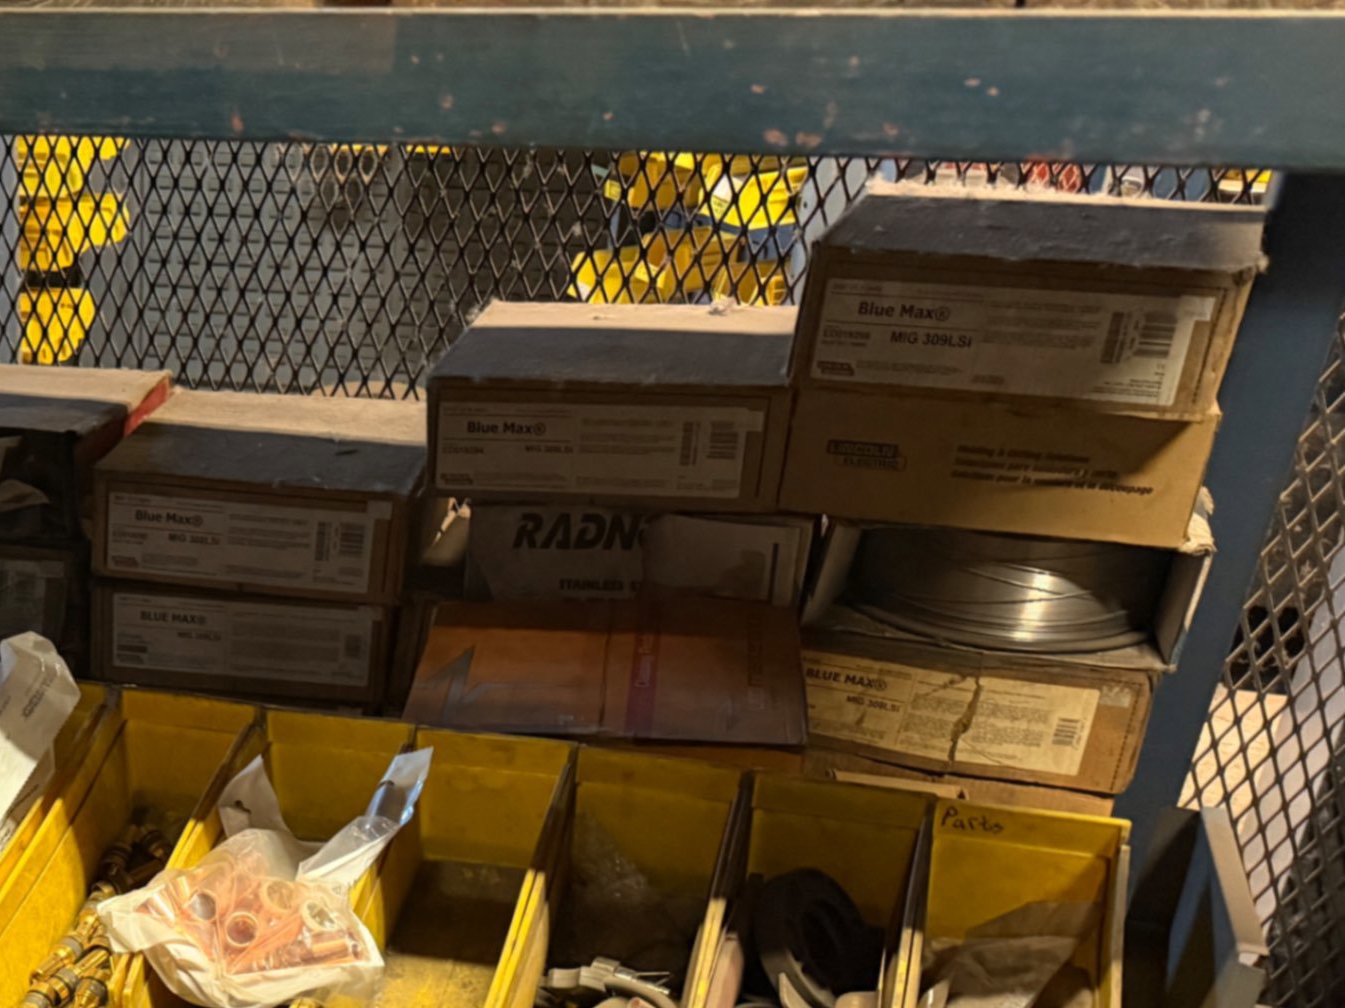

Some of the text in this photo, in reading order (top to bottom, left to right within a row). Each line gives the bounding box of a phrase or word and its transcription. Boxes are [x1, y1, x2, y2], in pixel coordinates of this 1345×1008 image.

[857, 301, 895, 318] Blue
[889, 330, 919, 345] MIG
[466, 421, 499, 434] Blue
[134, 509, 163, 523] Blue
[512, 512, 645, 551] RADN
[140, 610, 170, 622] BLUE
[805, 667, 840, 683] BLUE
[941, 805, 1003, 835] Parts
